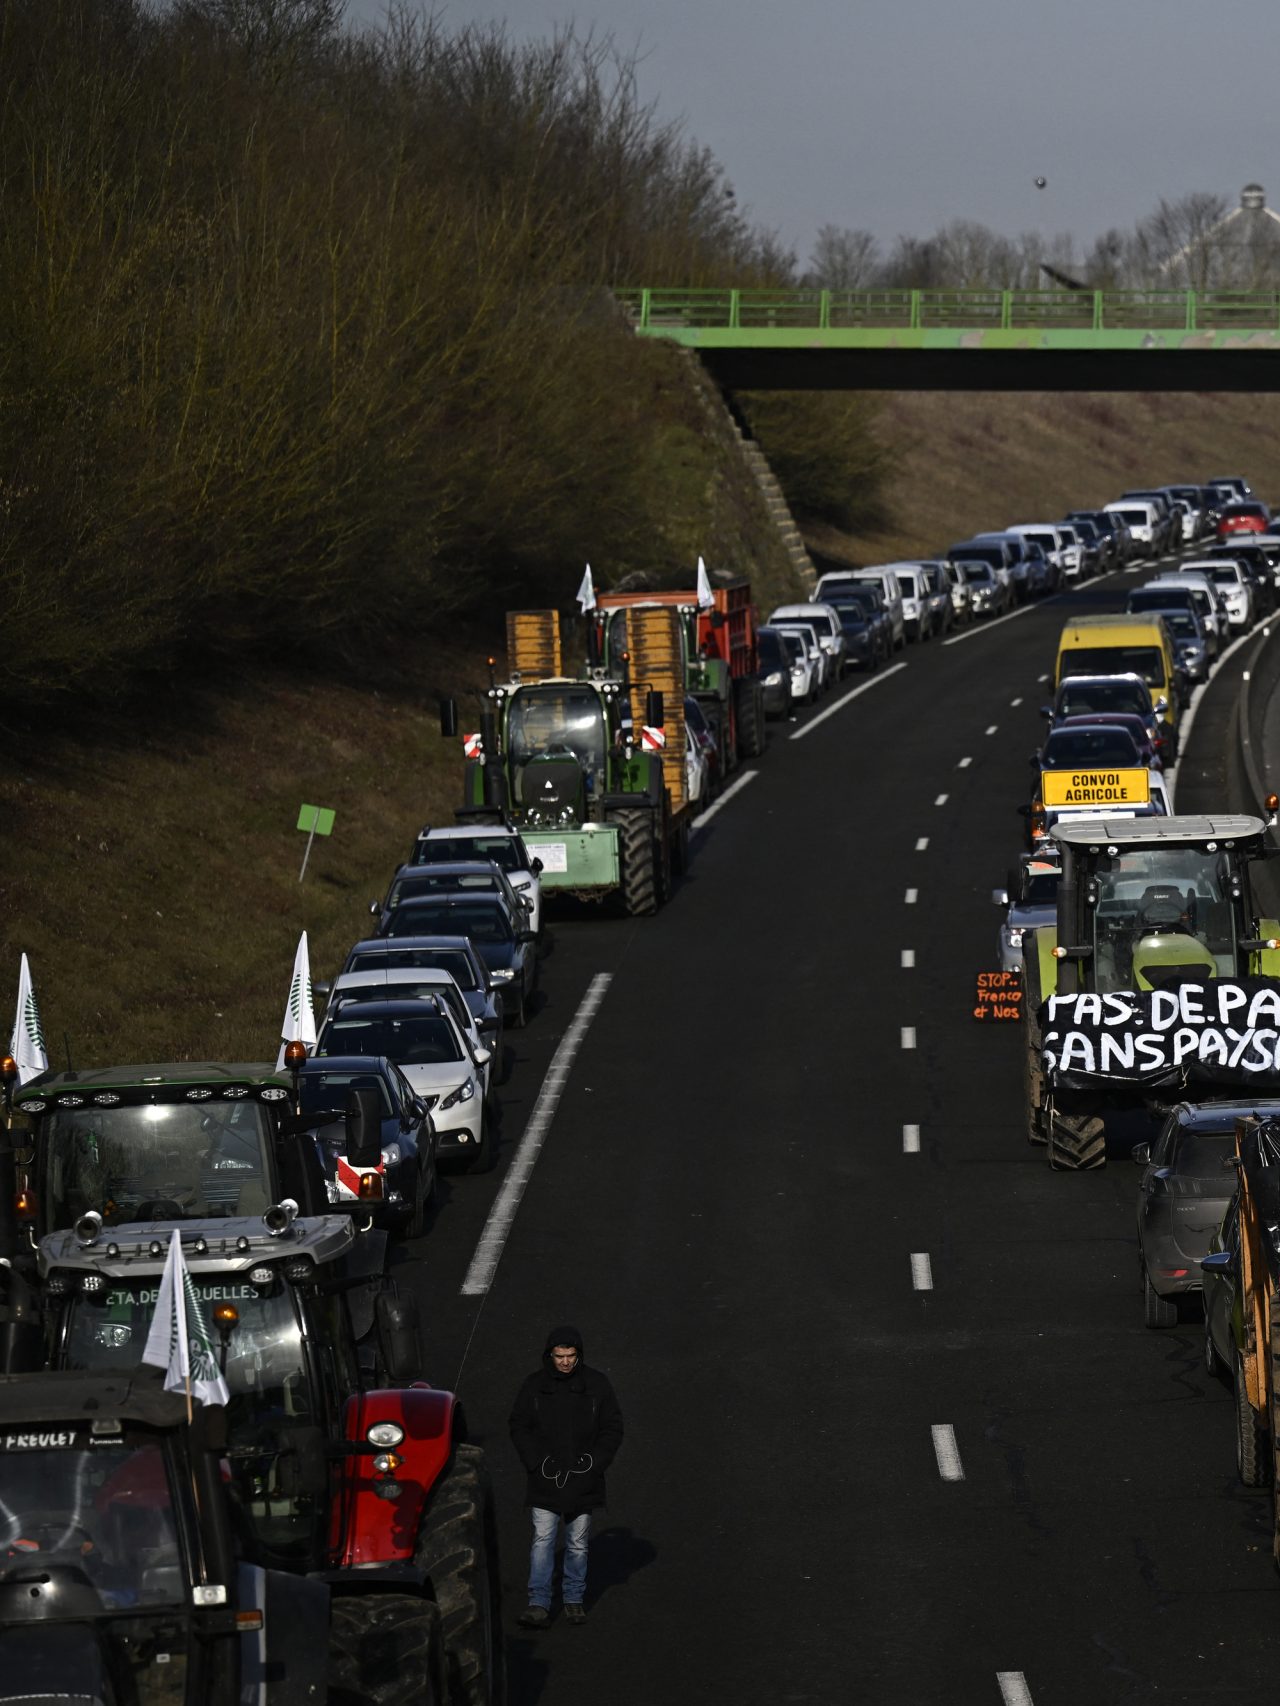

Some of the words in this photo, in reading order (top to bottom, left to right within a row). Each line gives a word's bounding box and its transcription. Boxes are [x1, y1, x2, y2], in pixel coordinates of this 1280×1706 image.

[1072, 774, 1120, 787] CONVOI
[1065, 788, 1128, 801] AGRICOLE
[993, 1005, 1019, 1018] Nos
